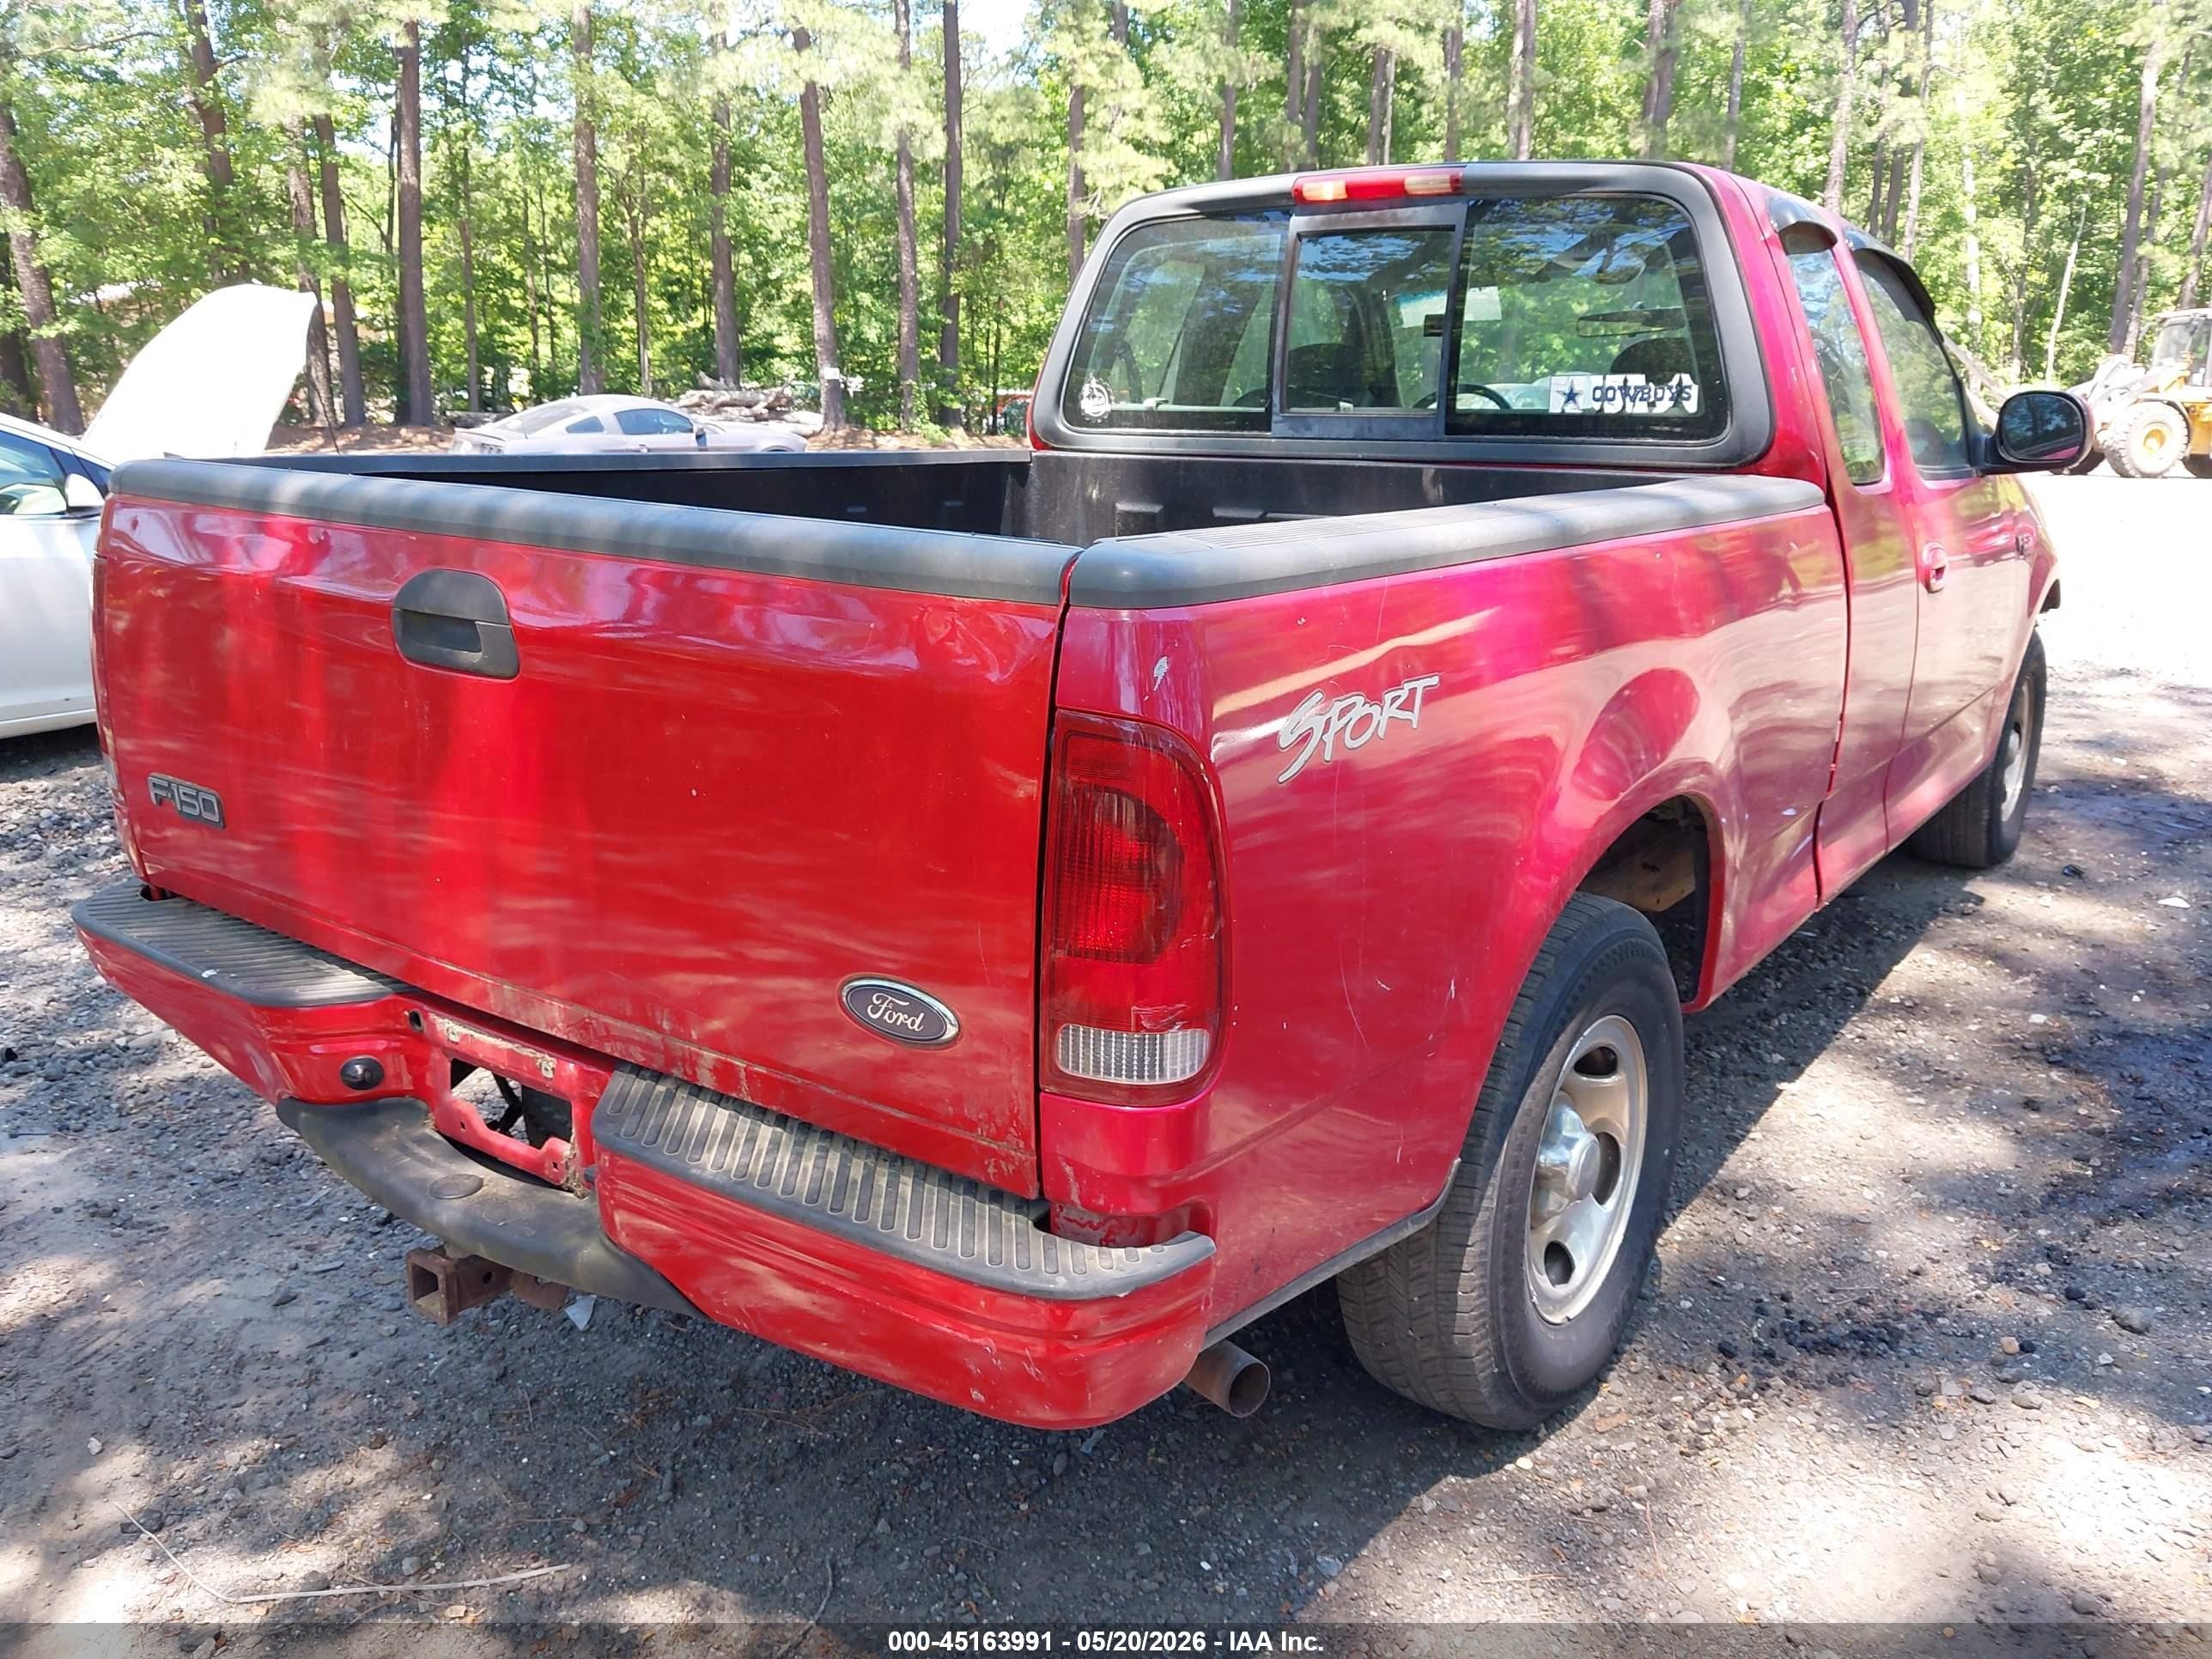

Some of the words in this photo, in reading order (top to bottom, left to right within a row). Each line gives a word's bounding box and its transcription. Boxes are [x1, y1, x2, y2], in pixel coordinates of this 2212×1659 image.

[1591, 383, 1693, 403] COWBOYS
[1278, 673, 1440, 784] SPORT
[866, 992, 925, 1033] Ford
